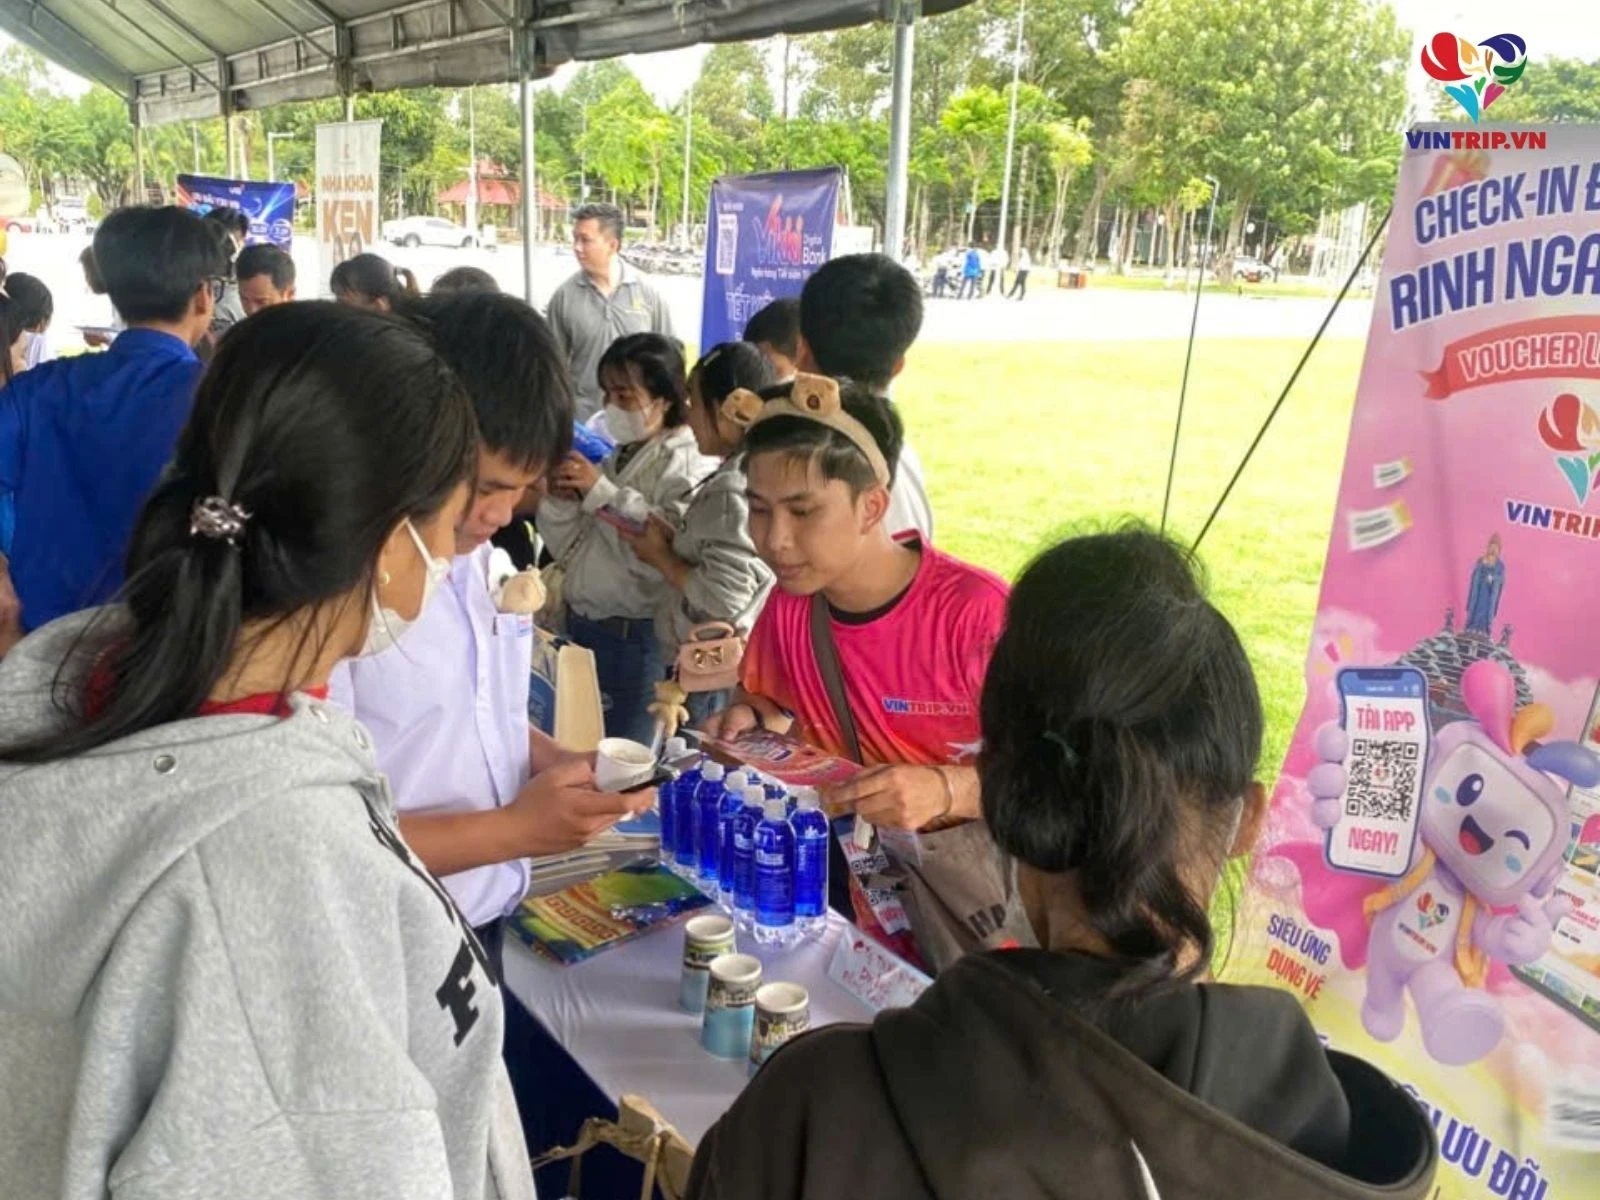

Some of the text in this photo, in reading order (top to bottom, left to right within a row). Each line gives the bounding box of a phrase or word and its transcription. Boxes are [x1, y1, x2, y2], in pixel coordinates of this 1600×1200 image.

[323, 200, 372, 245] KEN
[1415, 165, 1580, 244] CHECK-IN
[1391, 247, 1495, 332] RINH
[1460, 334, 1581, 380] VOUCHER
[1383, 709, 1416, 733] APP
[1348, 827, 1399, 856] NGAY!
[1267, 913, 1302, 948] SIÊU
[1266, 948, 1307, 988] DỤNG
